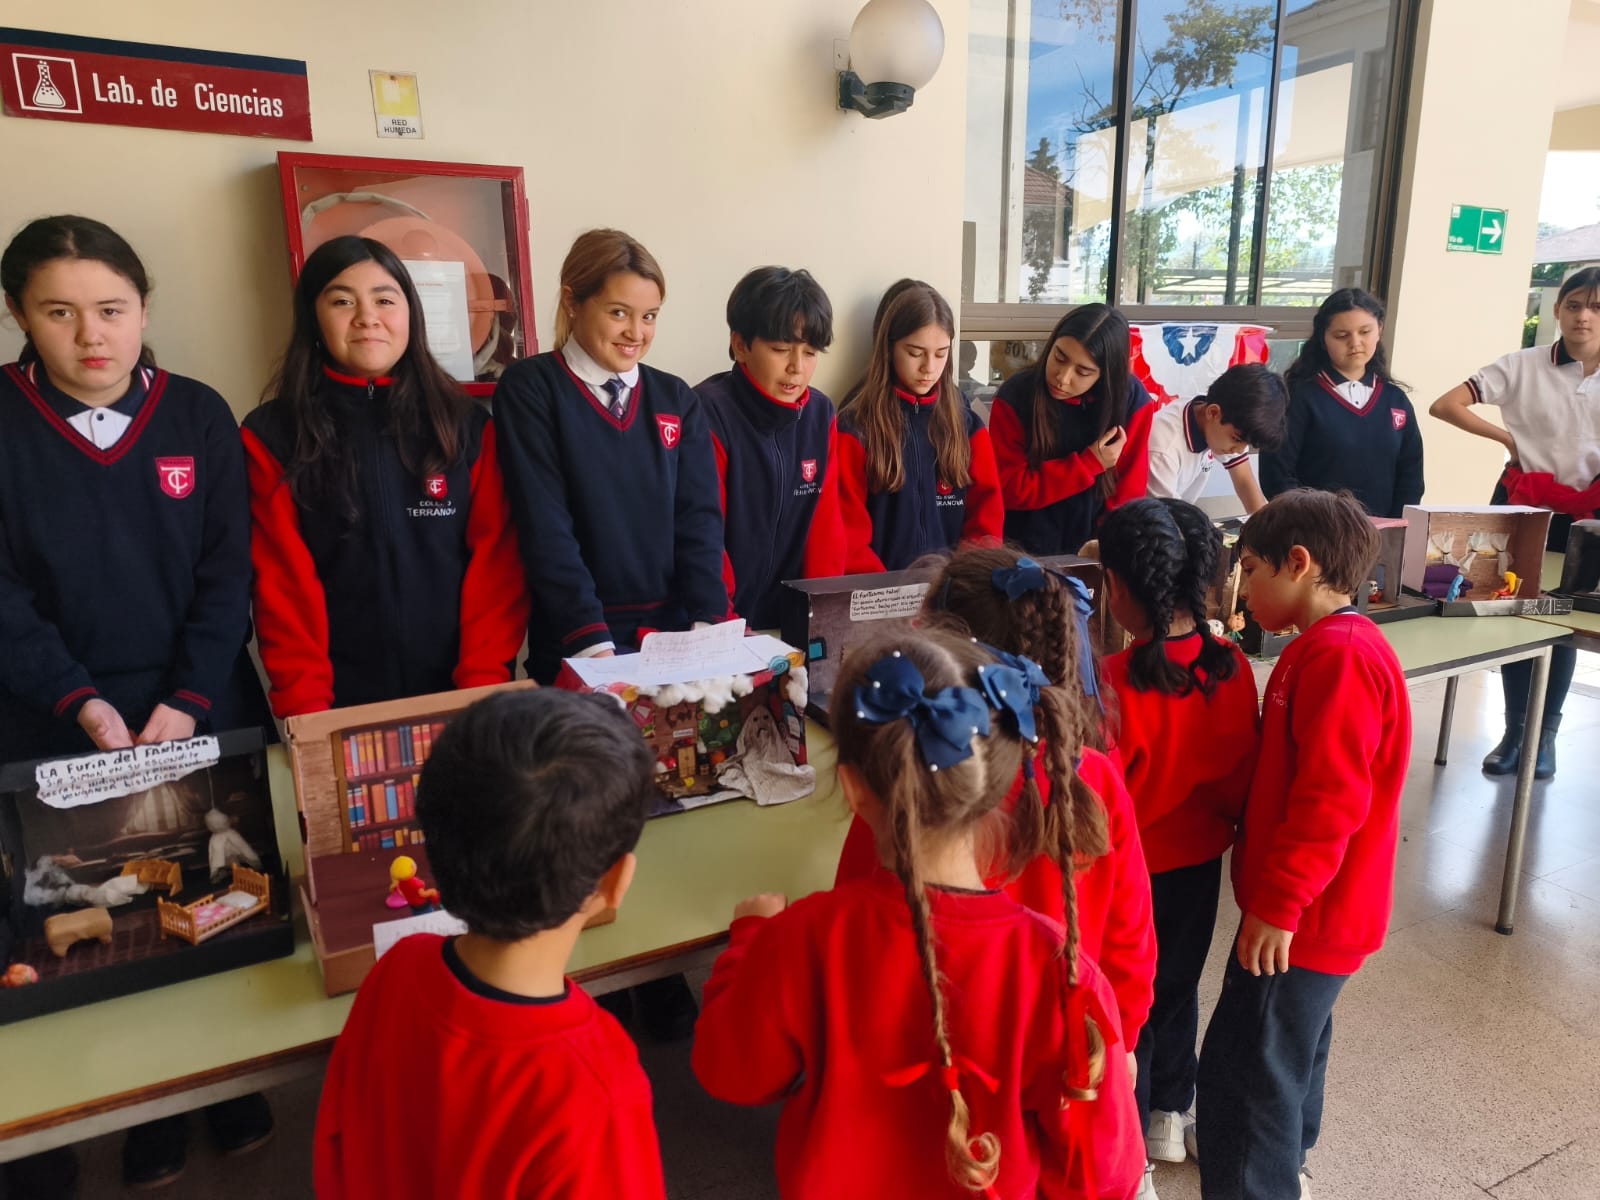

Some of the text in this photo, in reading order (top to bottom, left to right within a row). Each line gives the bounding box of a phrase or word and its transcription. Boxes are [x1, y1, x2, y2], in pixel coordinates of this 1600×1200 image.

[92, 72, 284, 118] Lab. de Ciencias
